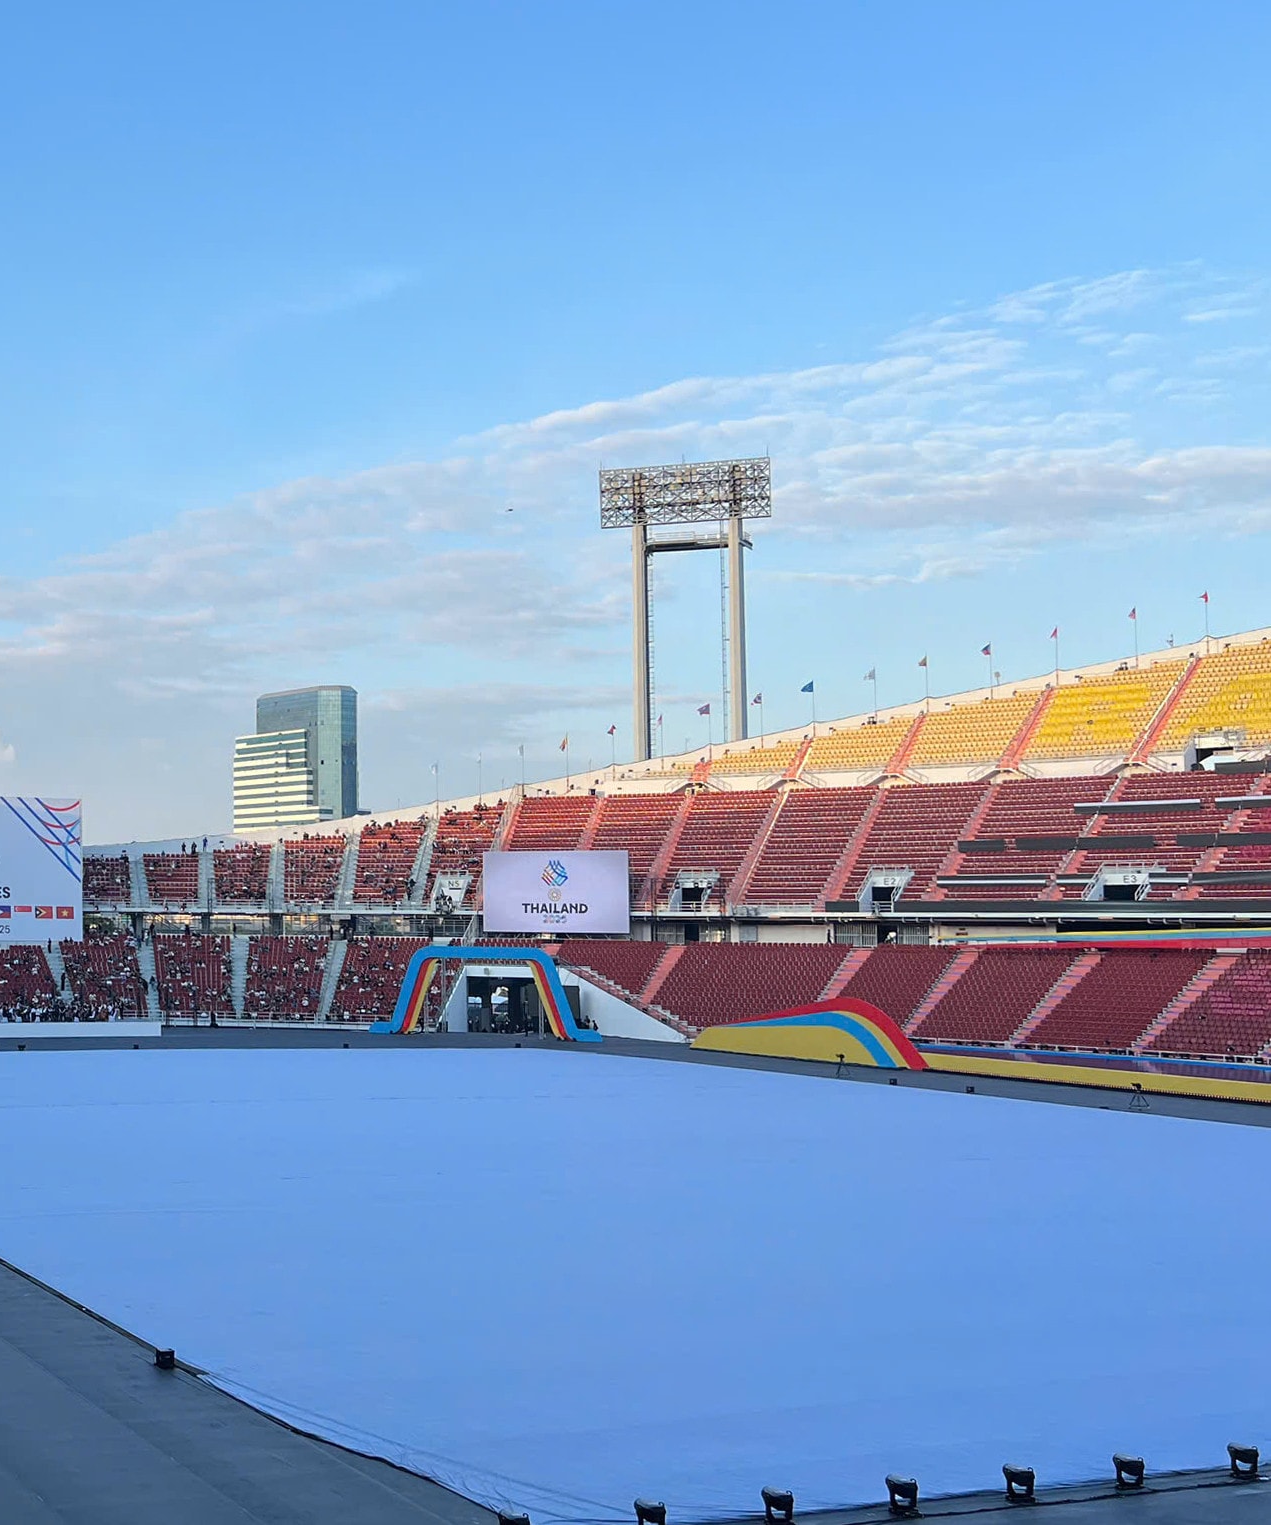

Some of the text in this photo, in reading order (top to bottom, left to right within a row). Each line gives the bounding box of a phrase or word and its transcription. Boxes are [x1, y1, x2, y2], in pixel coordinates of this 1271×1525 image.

[883, 877, 897, 885] E2
[1123, 874, 1137, 883] E3
[521, 903, 588, 914] THAILAND
